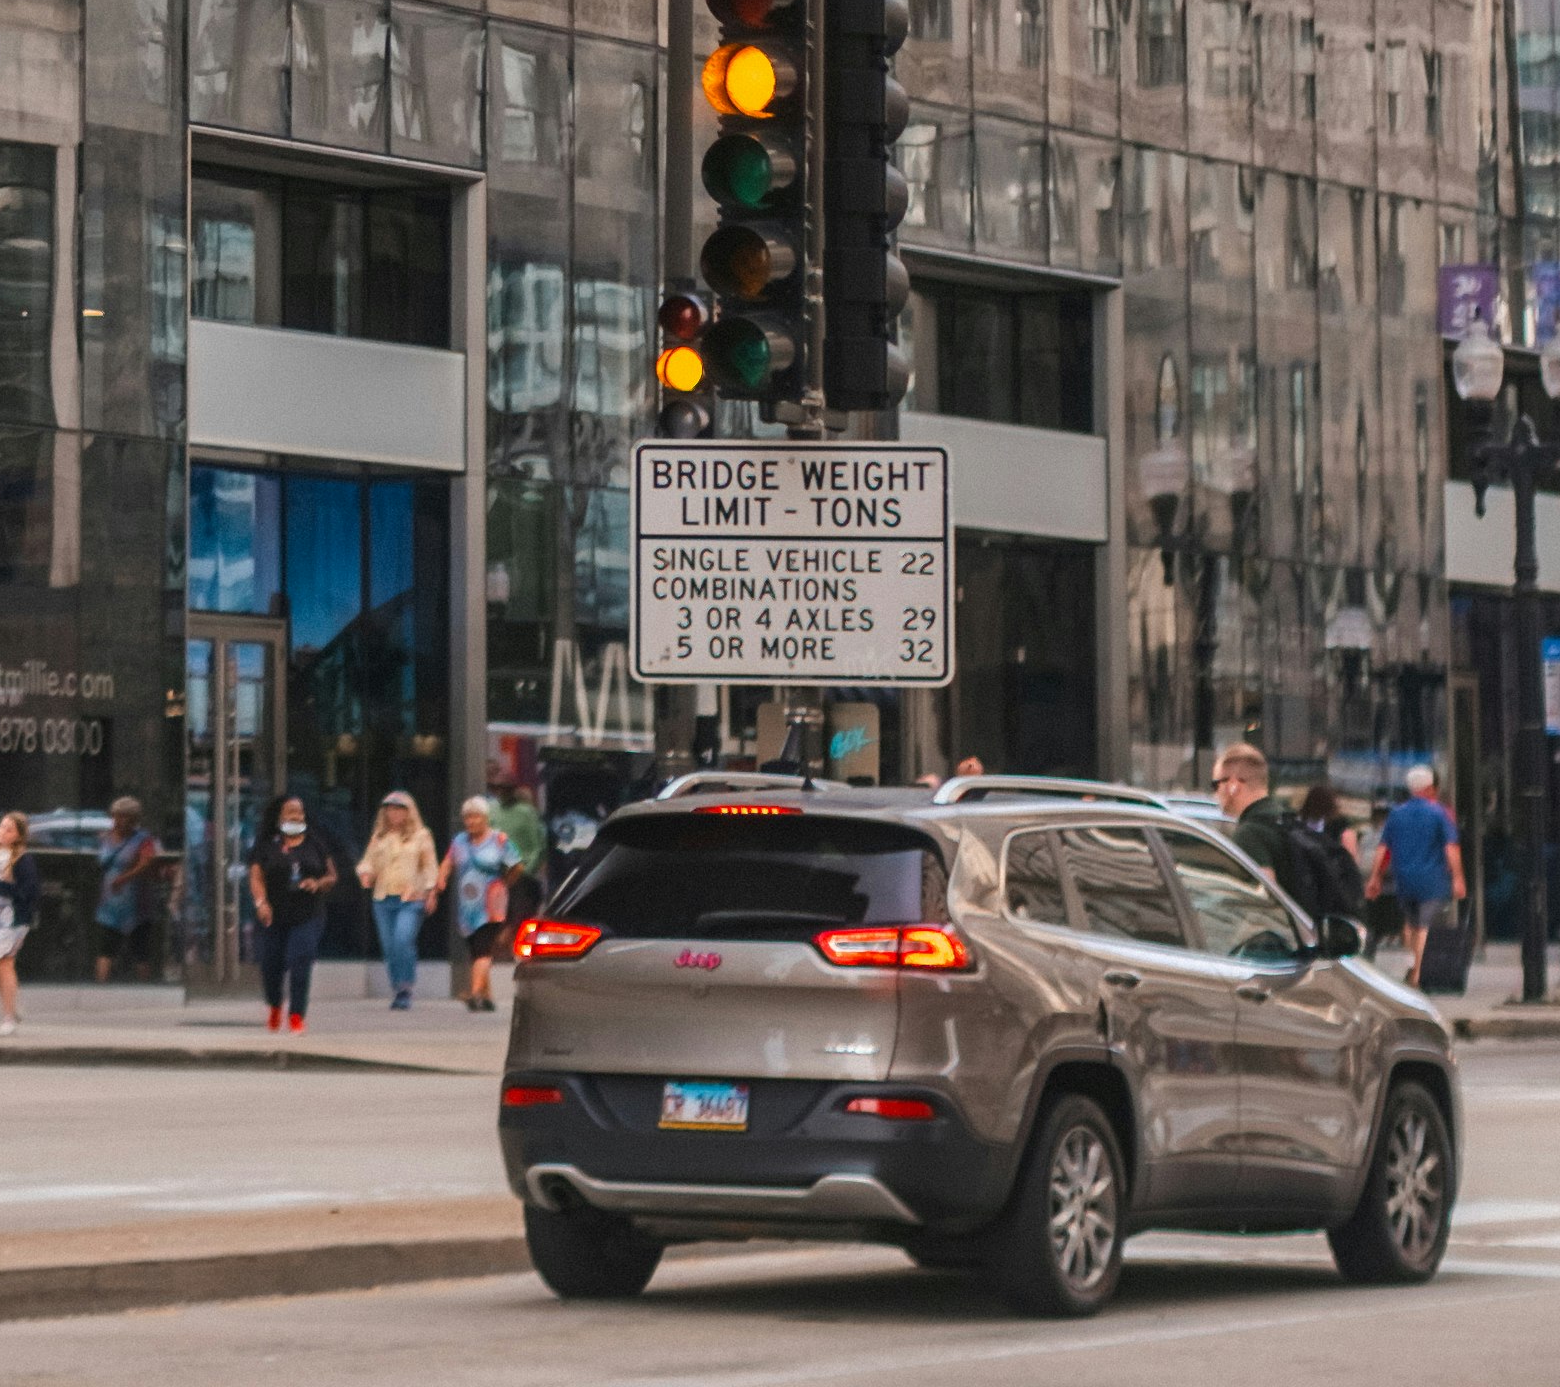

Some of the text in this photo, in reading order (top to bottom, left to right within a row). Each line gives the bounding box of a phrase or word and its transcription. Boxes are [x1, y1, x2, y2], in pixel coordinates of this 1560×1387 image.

[652, 459, 931, 491] BRIDGE WEIGHT
[682, 497, 772, 526] LIMIT
[810, 498, 902, 527] TONS
[652, 548, 935, 575] SINGLE VEHICLE 22
[652, 578, 857, 602] COMBINATIONS
[677, 606, 936, 632] 3 OR 4 AXLES 29
[677, 636, 933, 663] 5 OR MORE 32
[674, 948, 722, 971] Jeep
